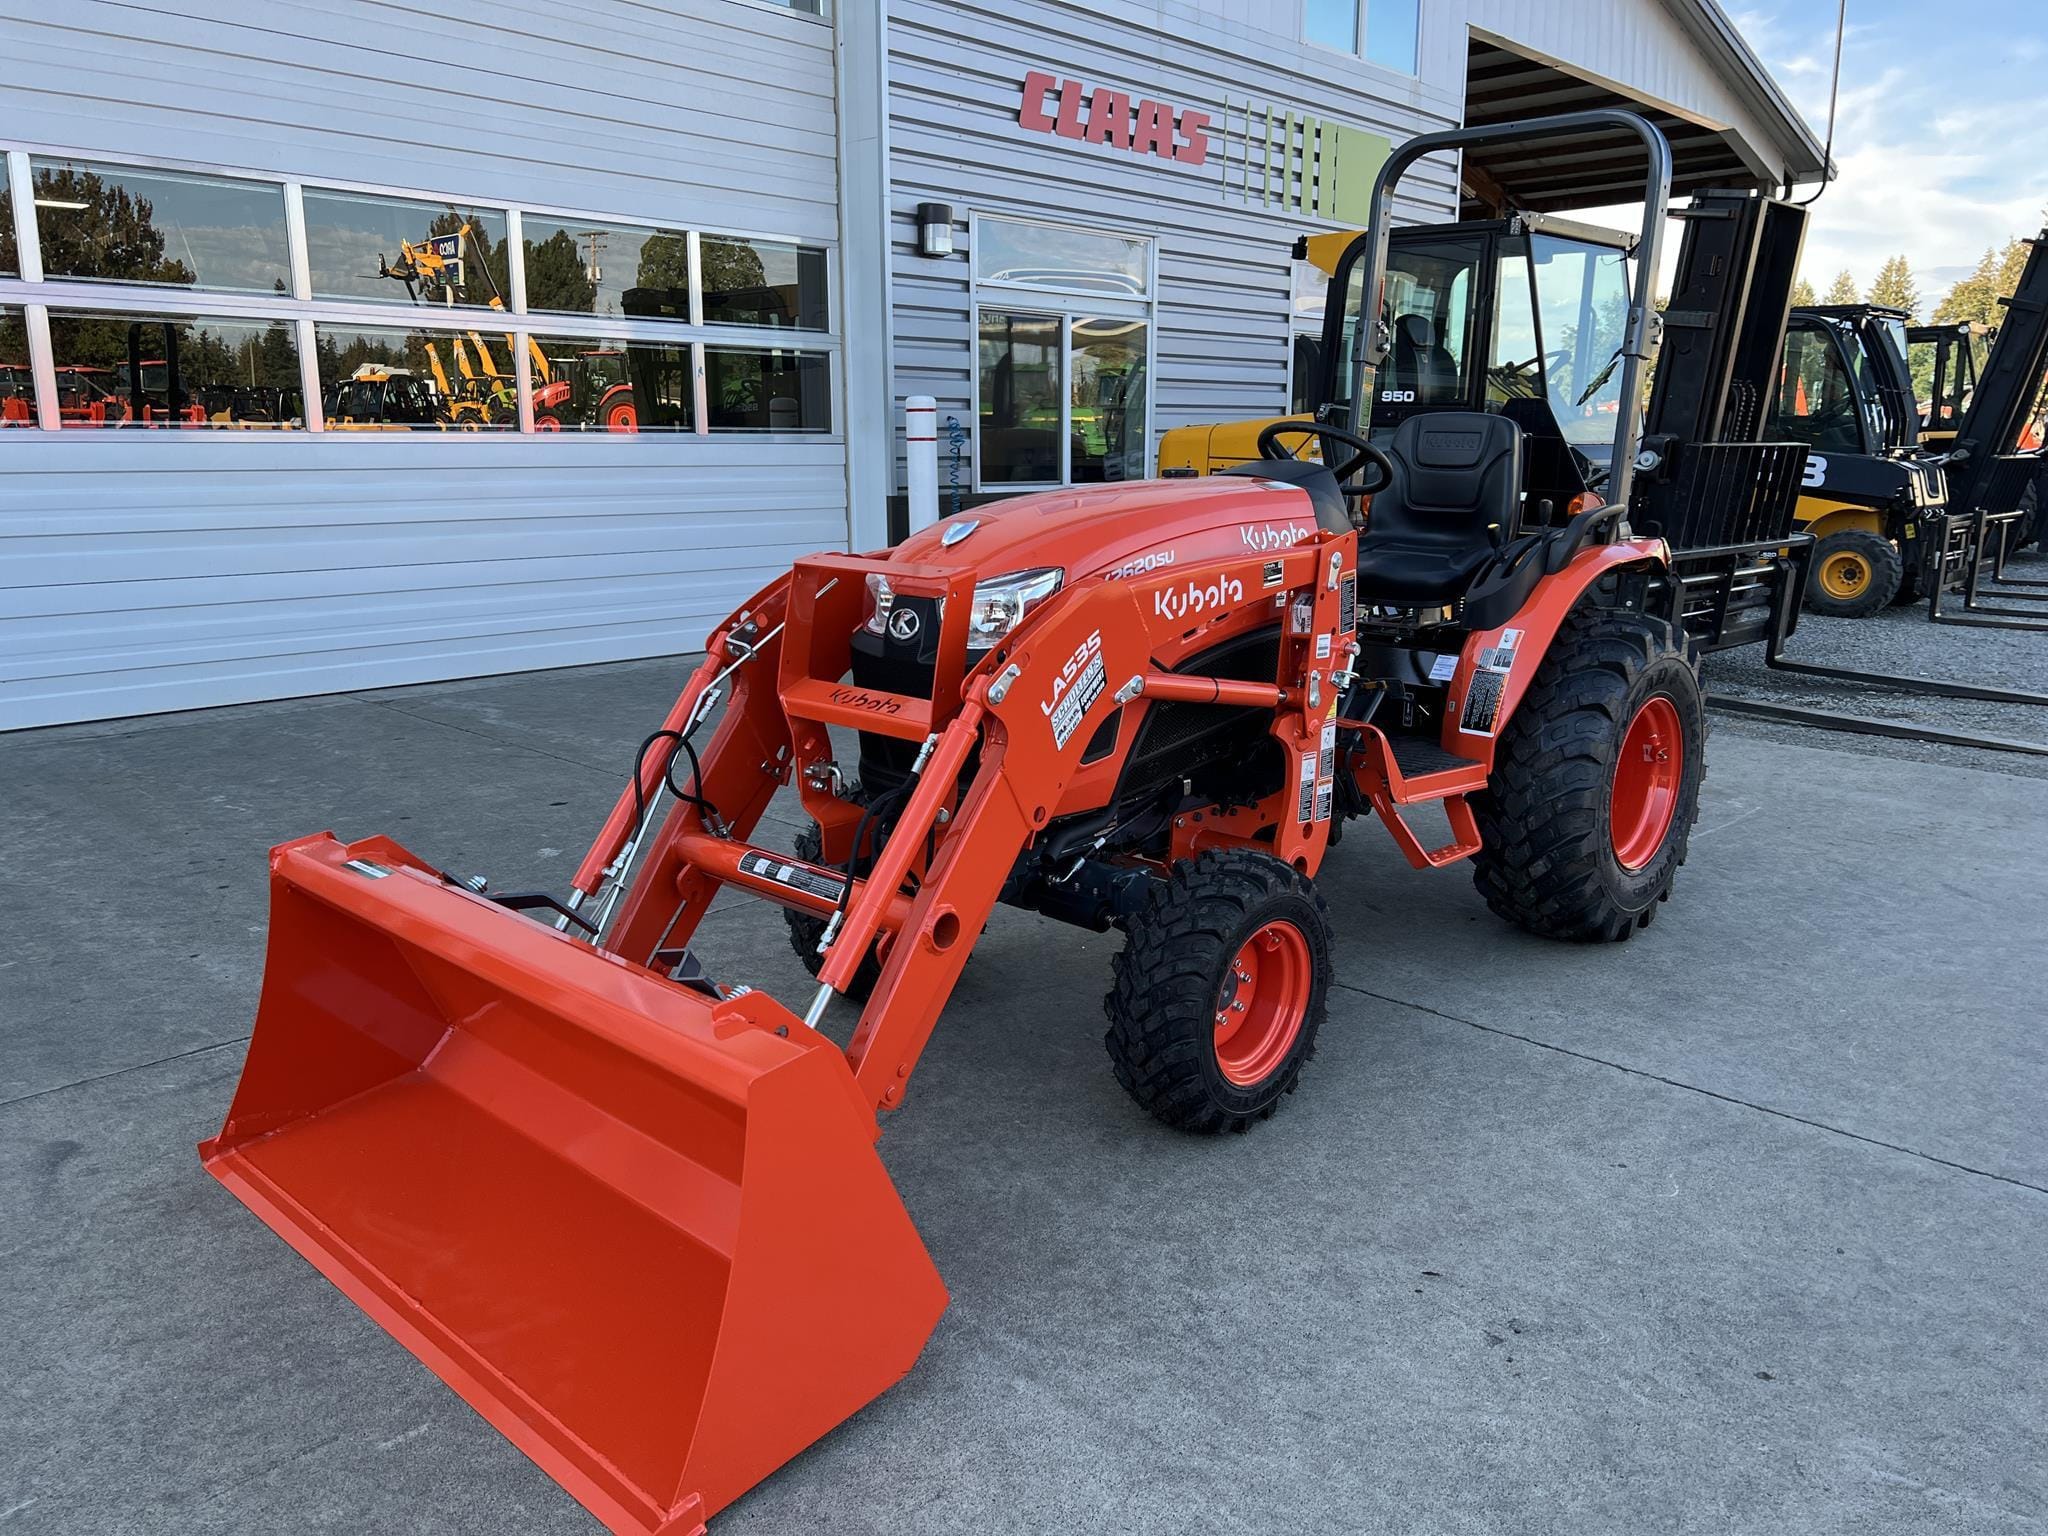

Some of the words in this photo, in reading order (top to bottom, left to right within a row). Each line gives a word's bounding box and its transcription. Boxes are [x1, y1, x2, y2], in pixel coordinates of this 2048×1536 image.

[1019, 71, 1211, 165] CLAAS
[1381, 390, 1415, 402] 950
[1155, 574, 1243, 620] Kubota
[1041, 629, 1101, 716] LA535
[829, 689, 902, 714] Kubota
